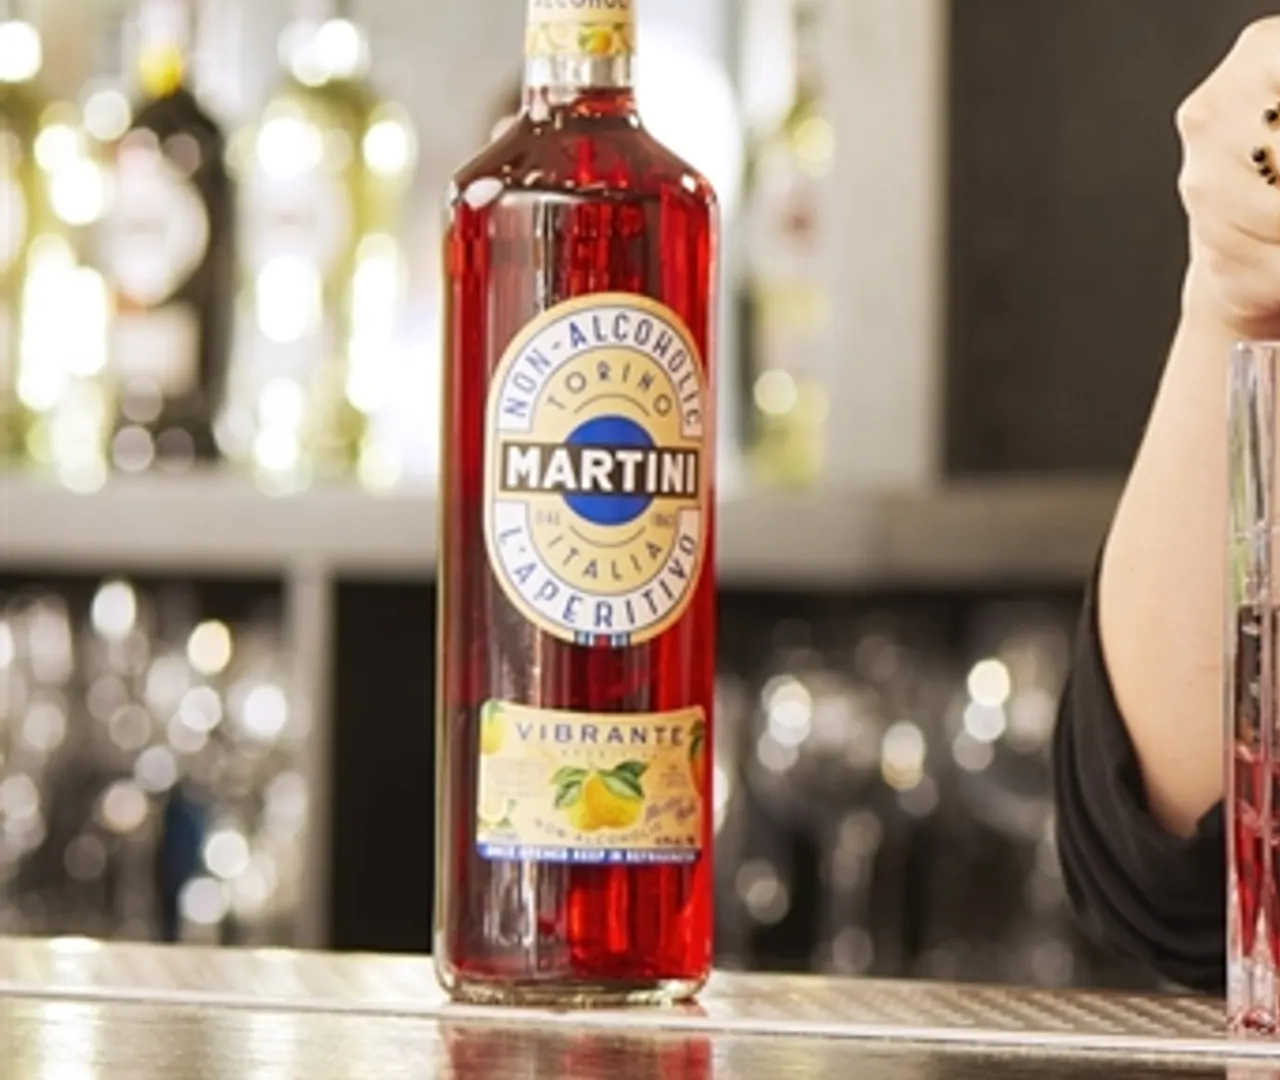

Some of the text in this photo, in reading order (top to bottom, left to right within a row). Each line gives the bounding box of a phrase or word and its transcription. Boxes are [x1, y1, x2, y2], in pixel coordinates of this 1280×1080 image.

[504, 313, 700, 427] NON-ALCOHOLIC
[546, 360, 673, 418] TORINO
[505, 444, 697, 494] MARTINI
[546, 533, 664, 582] ITALIA
[516, 723, 685, 746] VIBRANTE
